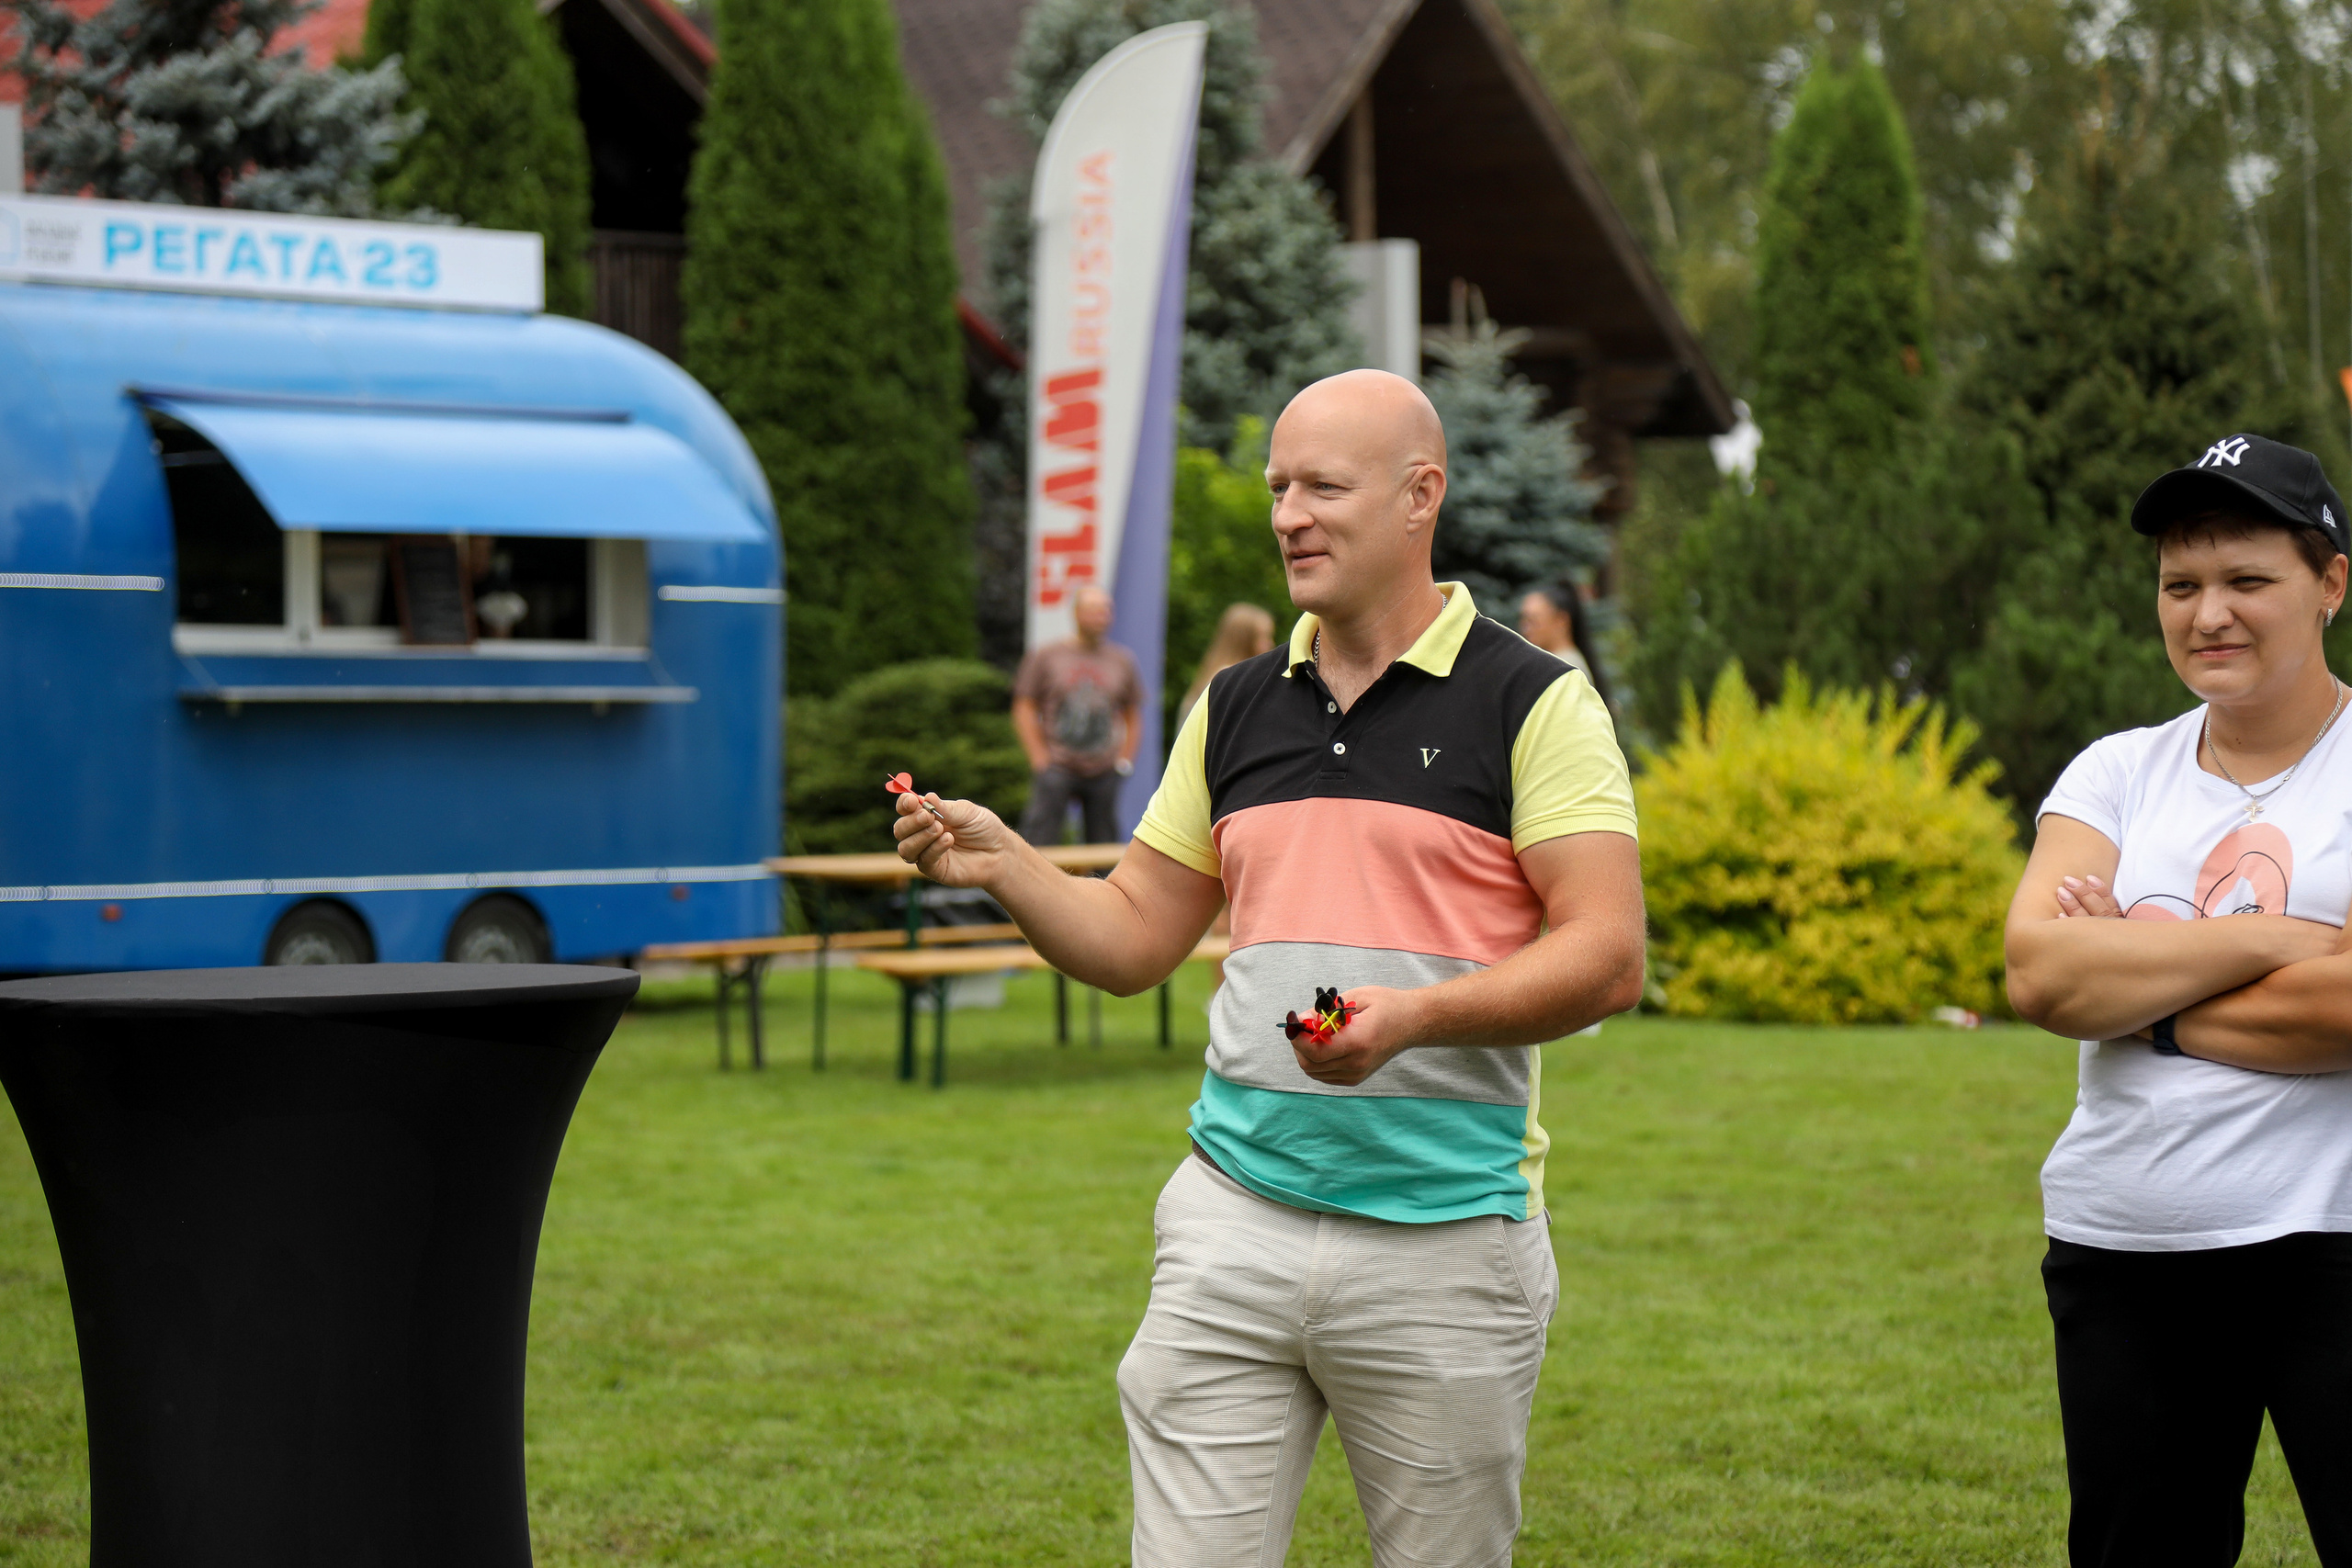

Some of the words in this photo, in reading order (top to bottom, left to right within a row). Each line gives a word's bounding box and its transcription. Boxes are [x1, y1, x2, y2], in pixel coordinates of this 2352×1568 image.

[103, 220, 346, 285] РЕГАТА
[363, 242, 438, 288] 23
[1069, 151, 1114, 357] RUSSIA
[2197, 436, 2251, 468] NY
[1419, 748, 1442, 769] V
